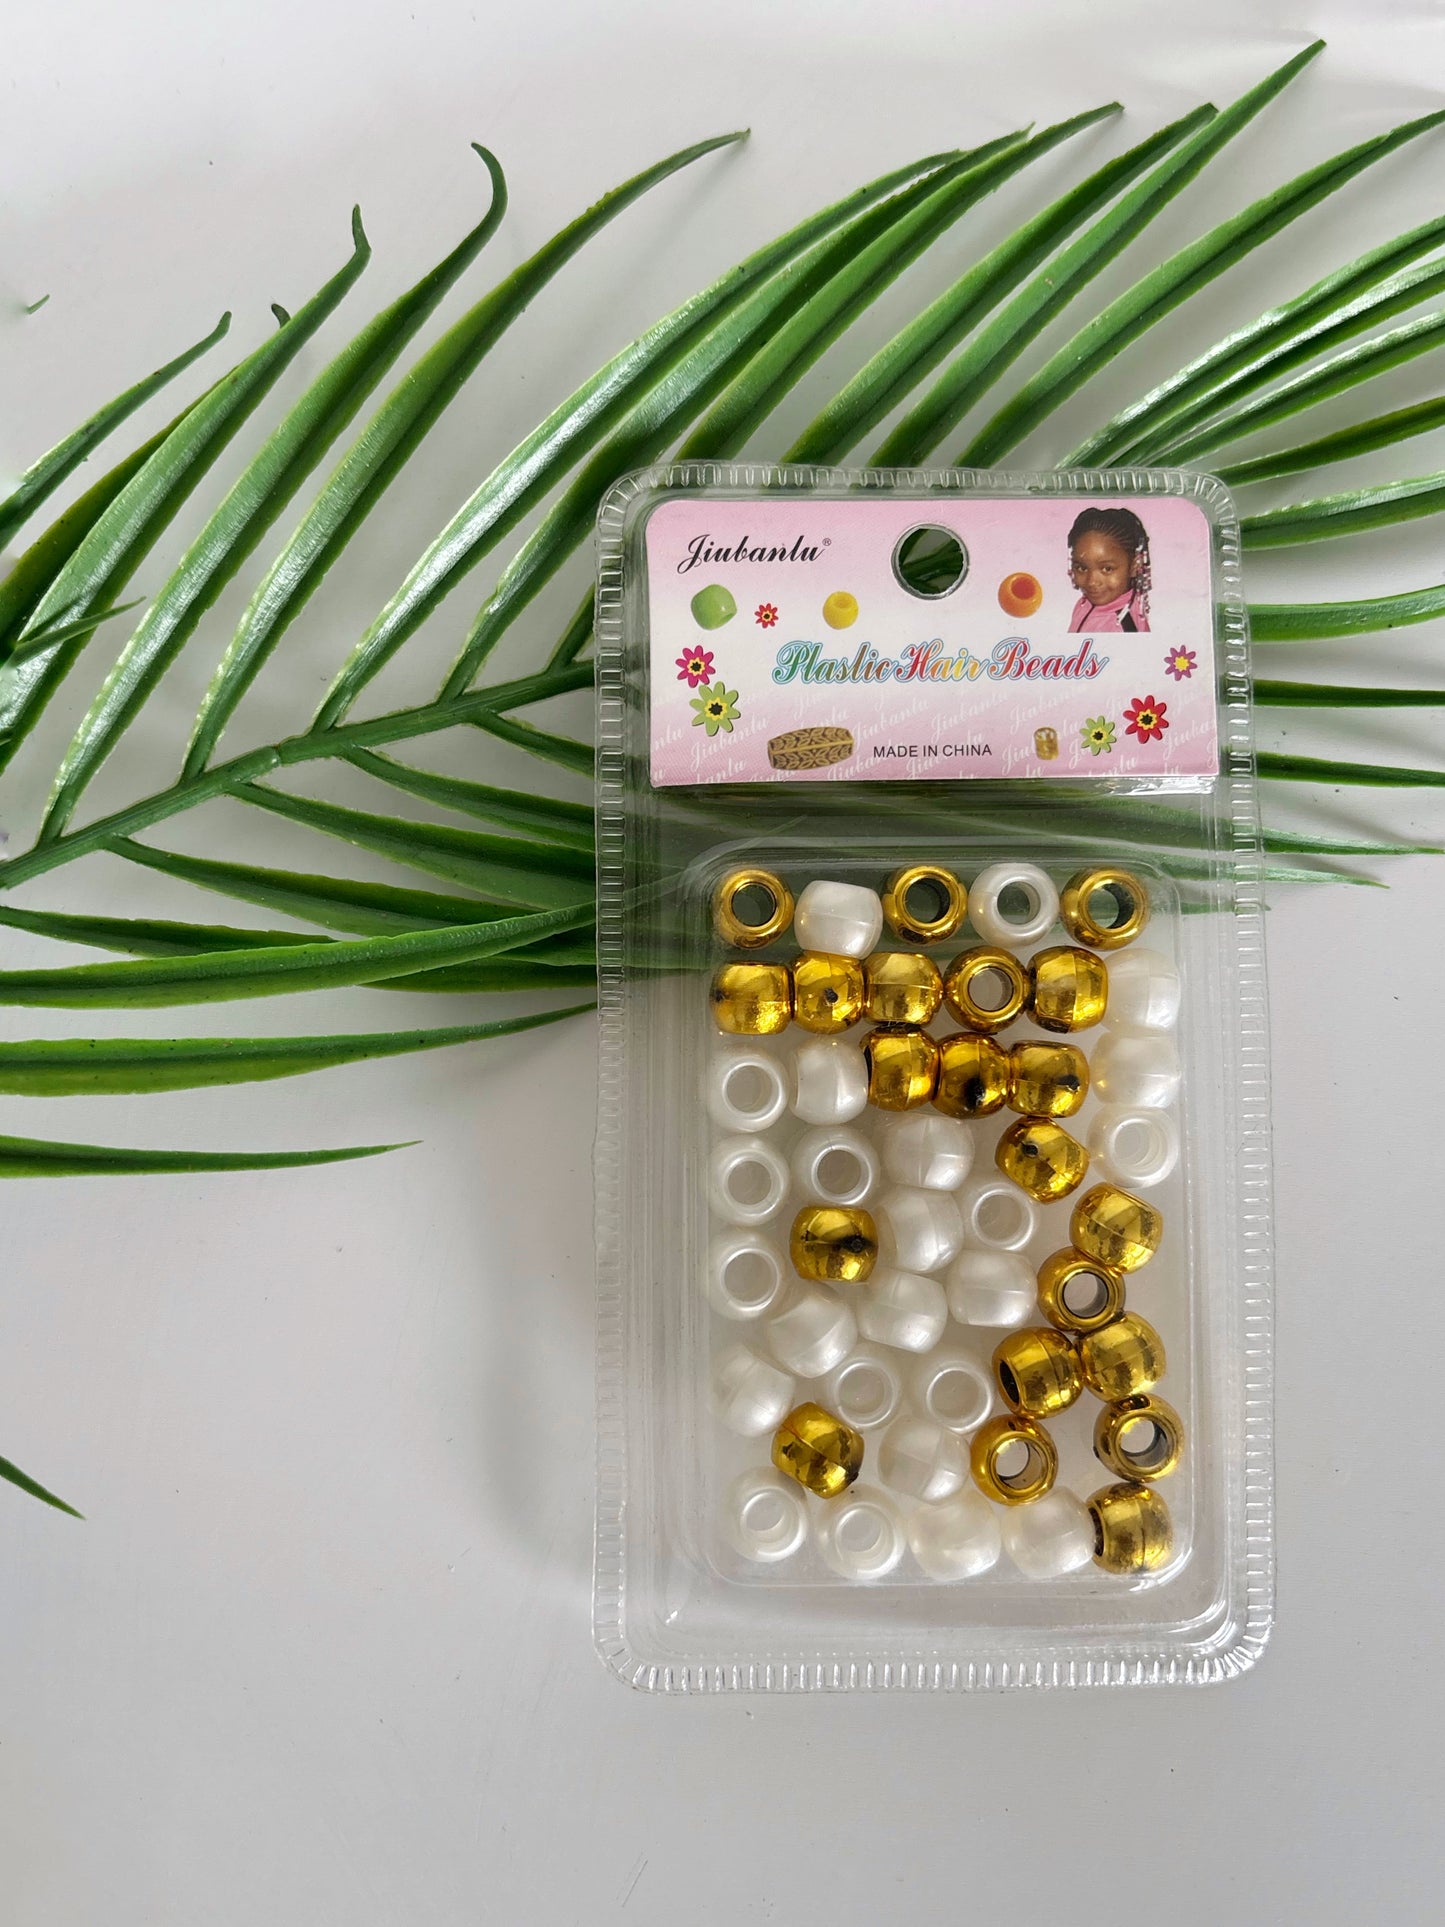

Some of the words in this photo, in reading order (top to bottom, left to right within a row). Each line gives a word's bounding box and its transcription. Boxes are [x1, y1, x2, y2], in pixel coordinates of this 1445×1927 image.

[895, 637, 989, 683] Hair
[988, 636, 1110, 681] Beads
[873, 745, 919, 758] MADE
[923, 744, 938, 758] IN
[942, 743, 992, 757] CHINA
